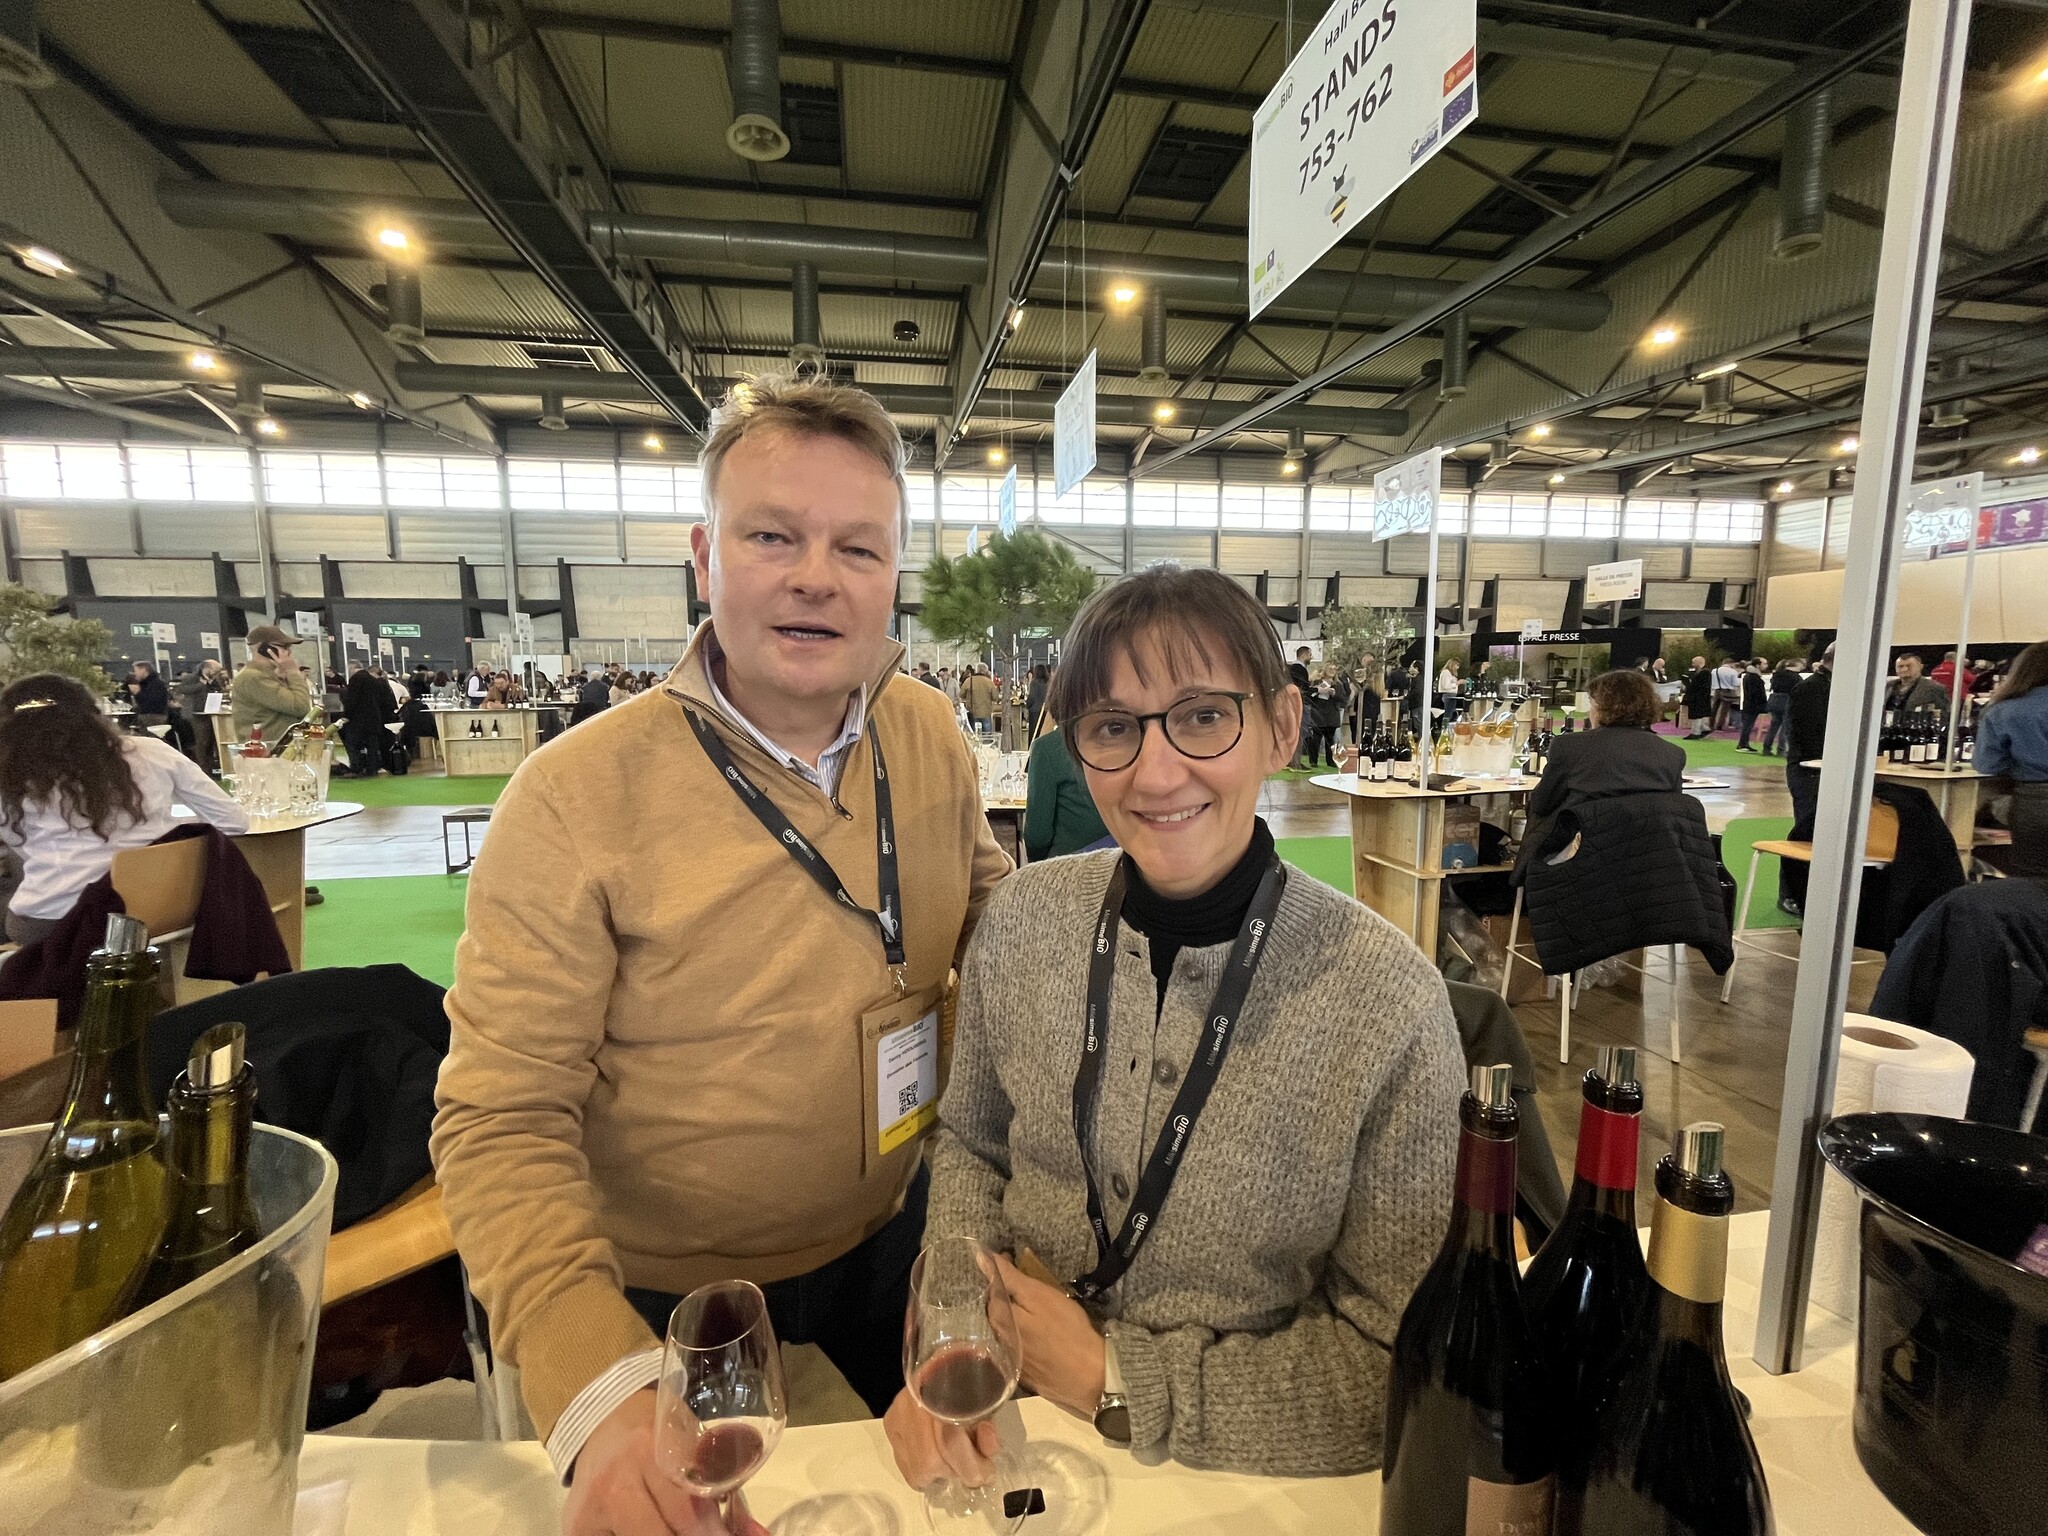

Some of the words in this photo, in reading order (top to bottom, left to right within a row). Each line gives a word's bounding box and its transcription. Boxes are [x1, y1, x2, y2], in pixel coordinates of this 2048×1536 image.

[1300, 0, 1397, 142] STANDS
[1324, 8, 1348, 56] Hall
[1300, 63, 1394, 195] 753-762
[1549, 632, 1580, 641] PRESSE
